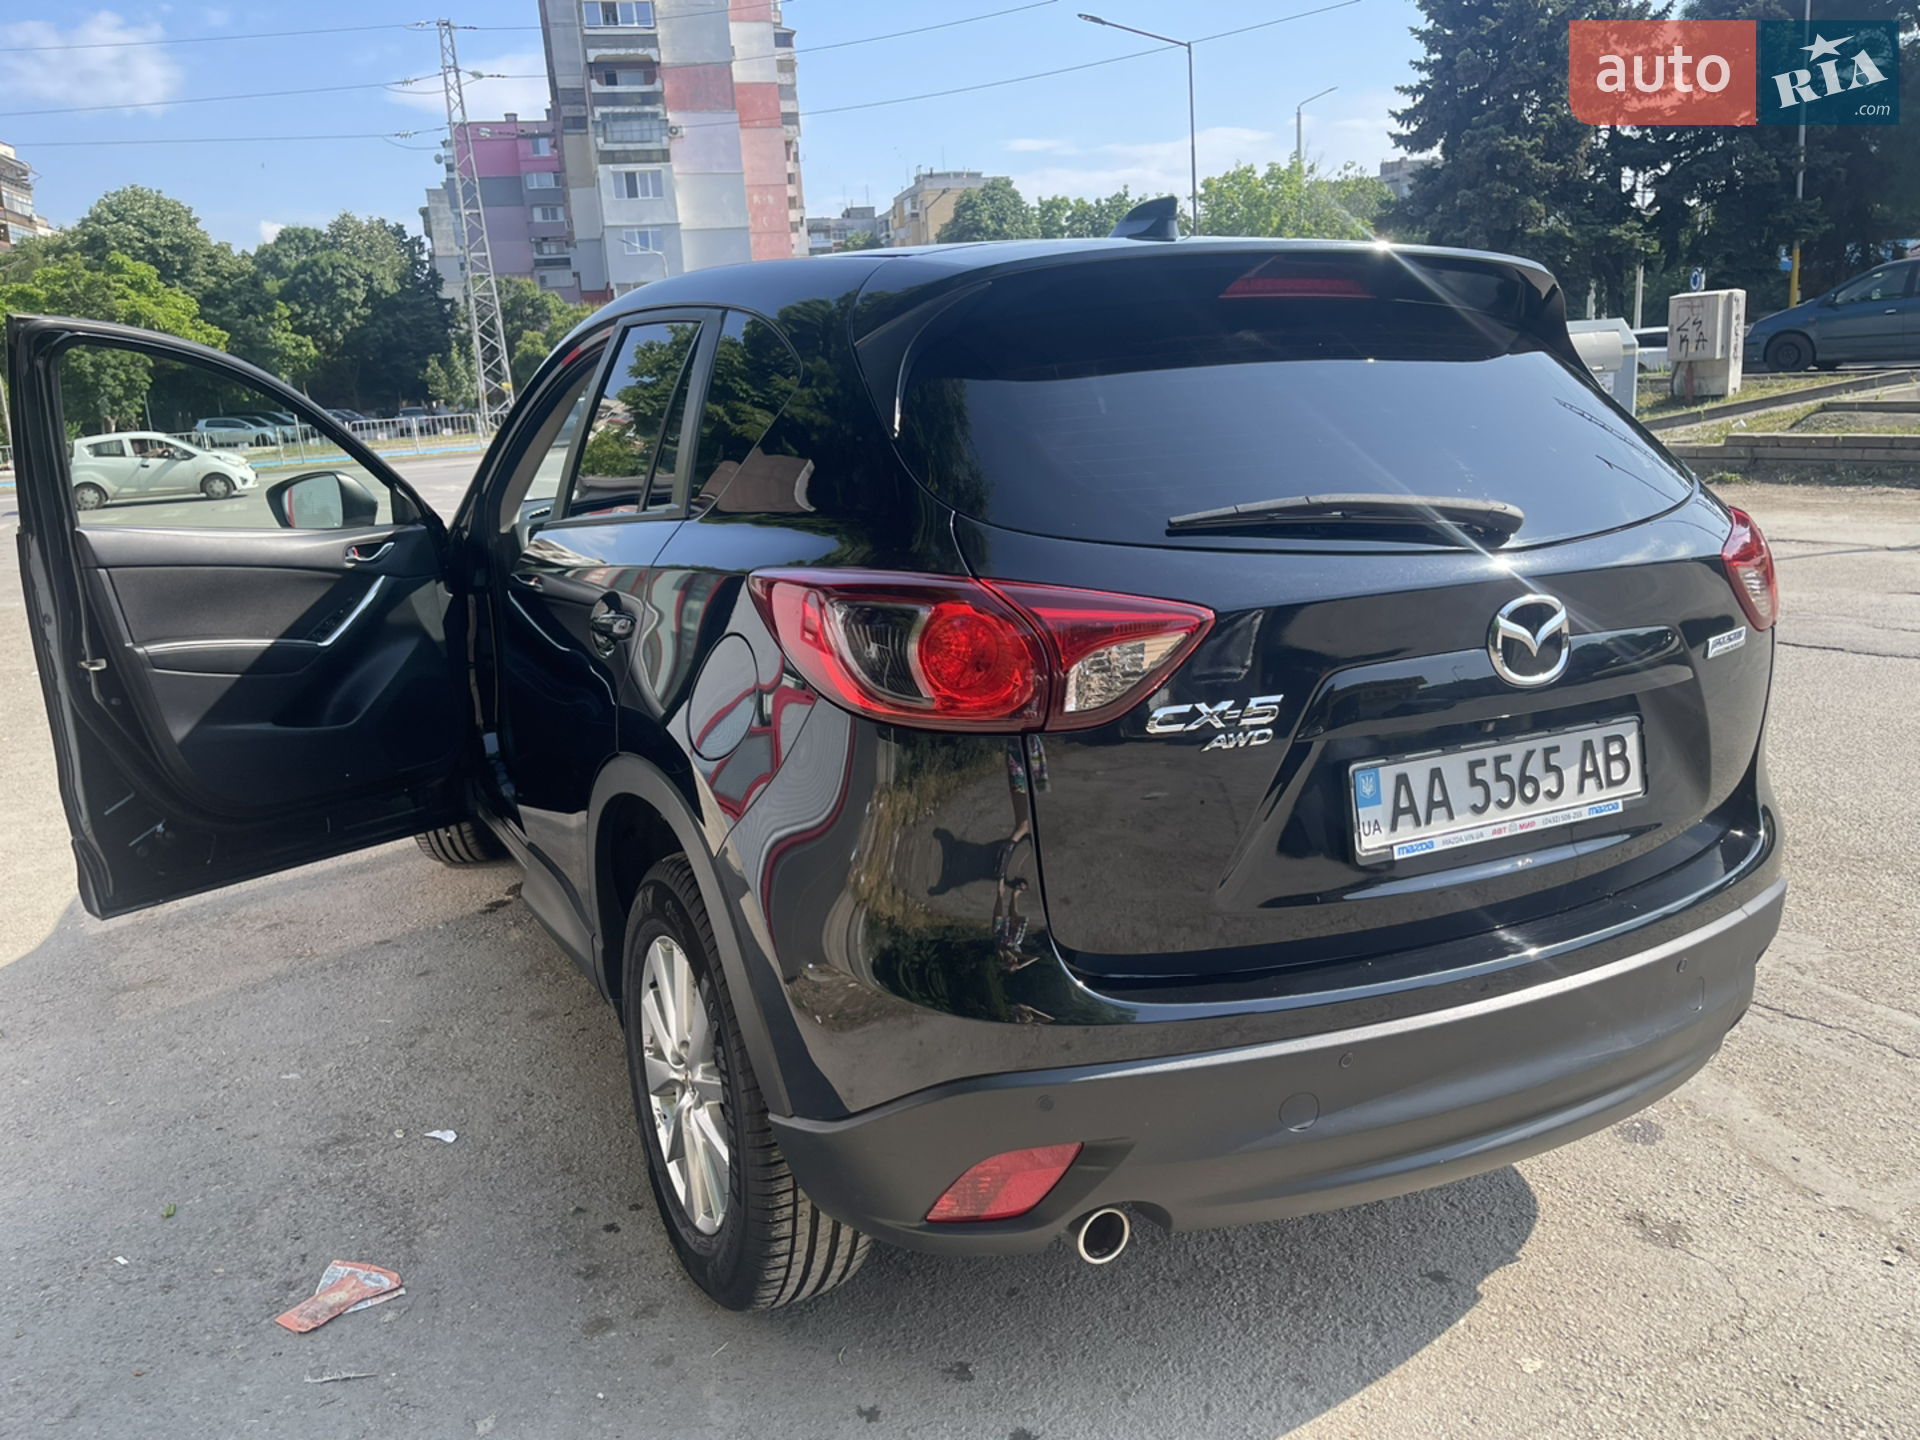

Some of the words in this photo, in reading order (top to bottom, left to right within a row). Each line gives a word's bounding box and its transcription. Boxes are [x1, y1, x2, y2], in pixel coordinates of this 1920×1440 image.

[1146, 694, 1284, 733] CX-5
[1200, 728, 1273, 752] AWD
[1389, 766, 1455, 833] AA
[1467, 745, 1565, 816] 5565
[1577, 734, 1631, 795] AB
[1588, 802, 1620, 816] mazda
[1361, 819, 1382, 837] UA
[1397, 840, 1434, 856] mazda
